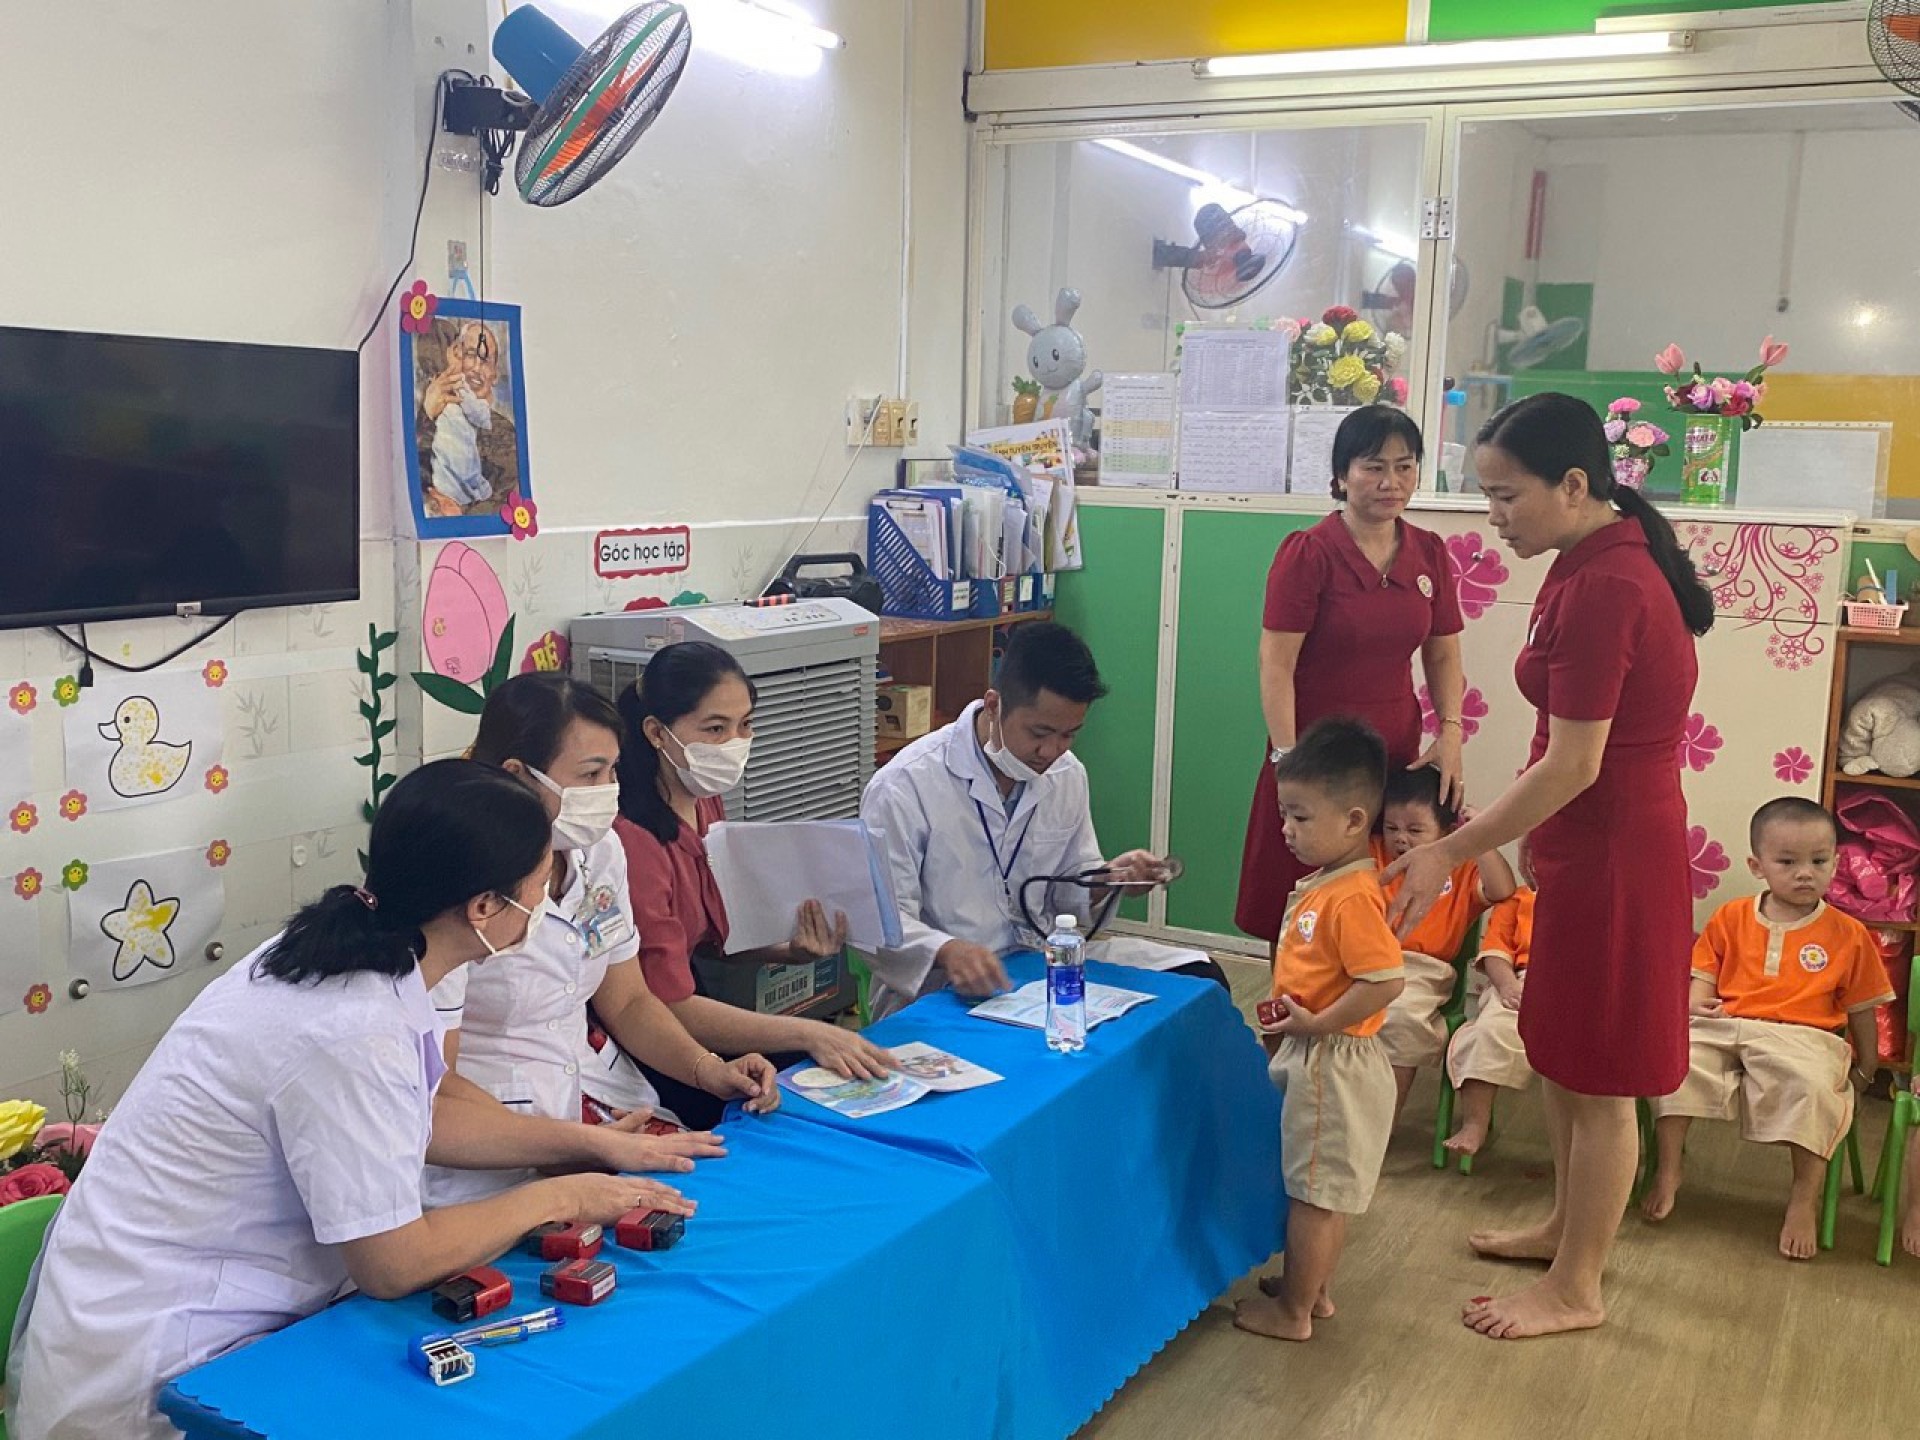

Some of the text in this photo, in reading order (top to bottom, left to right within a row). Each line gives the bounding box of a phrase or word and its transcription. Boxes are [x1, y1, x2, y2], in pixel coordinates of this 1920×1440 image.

[600, 541, 685, 564] Góc học tập
[532, 632, 561, 671] BÉ
